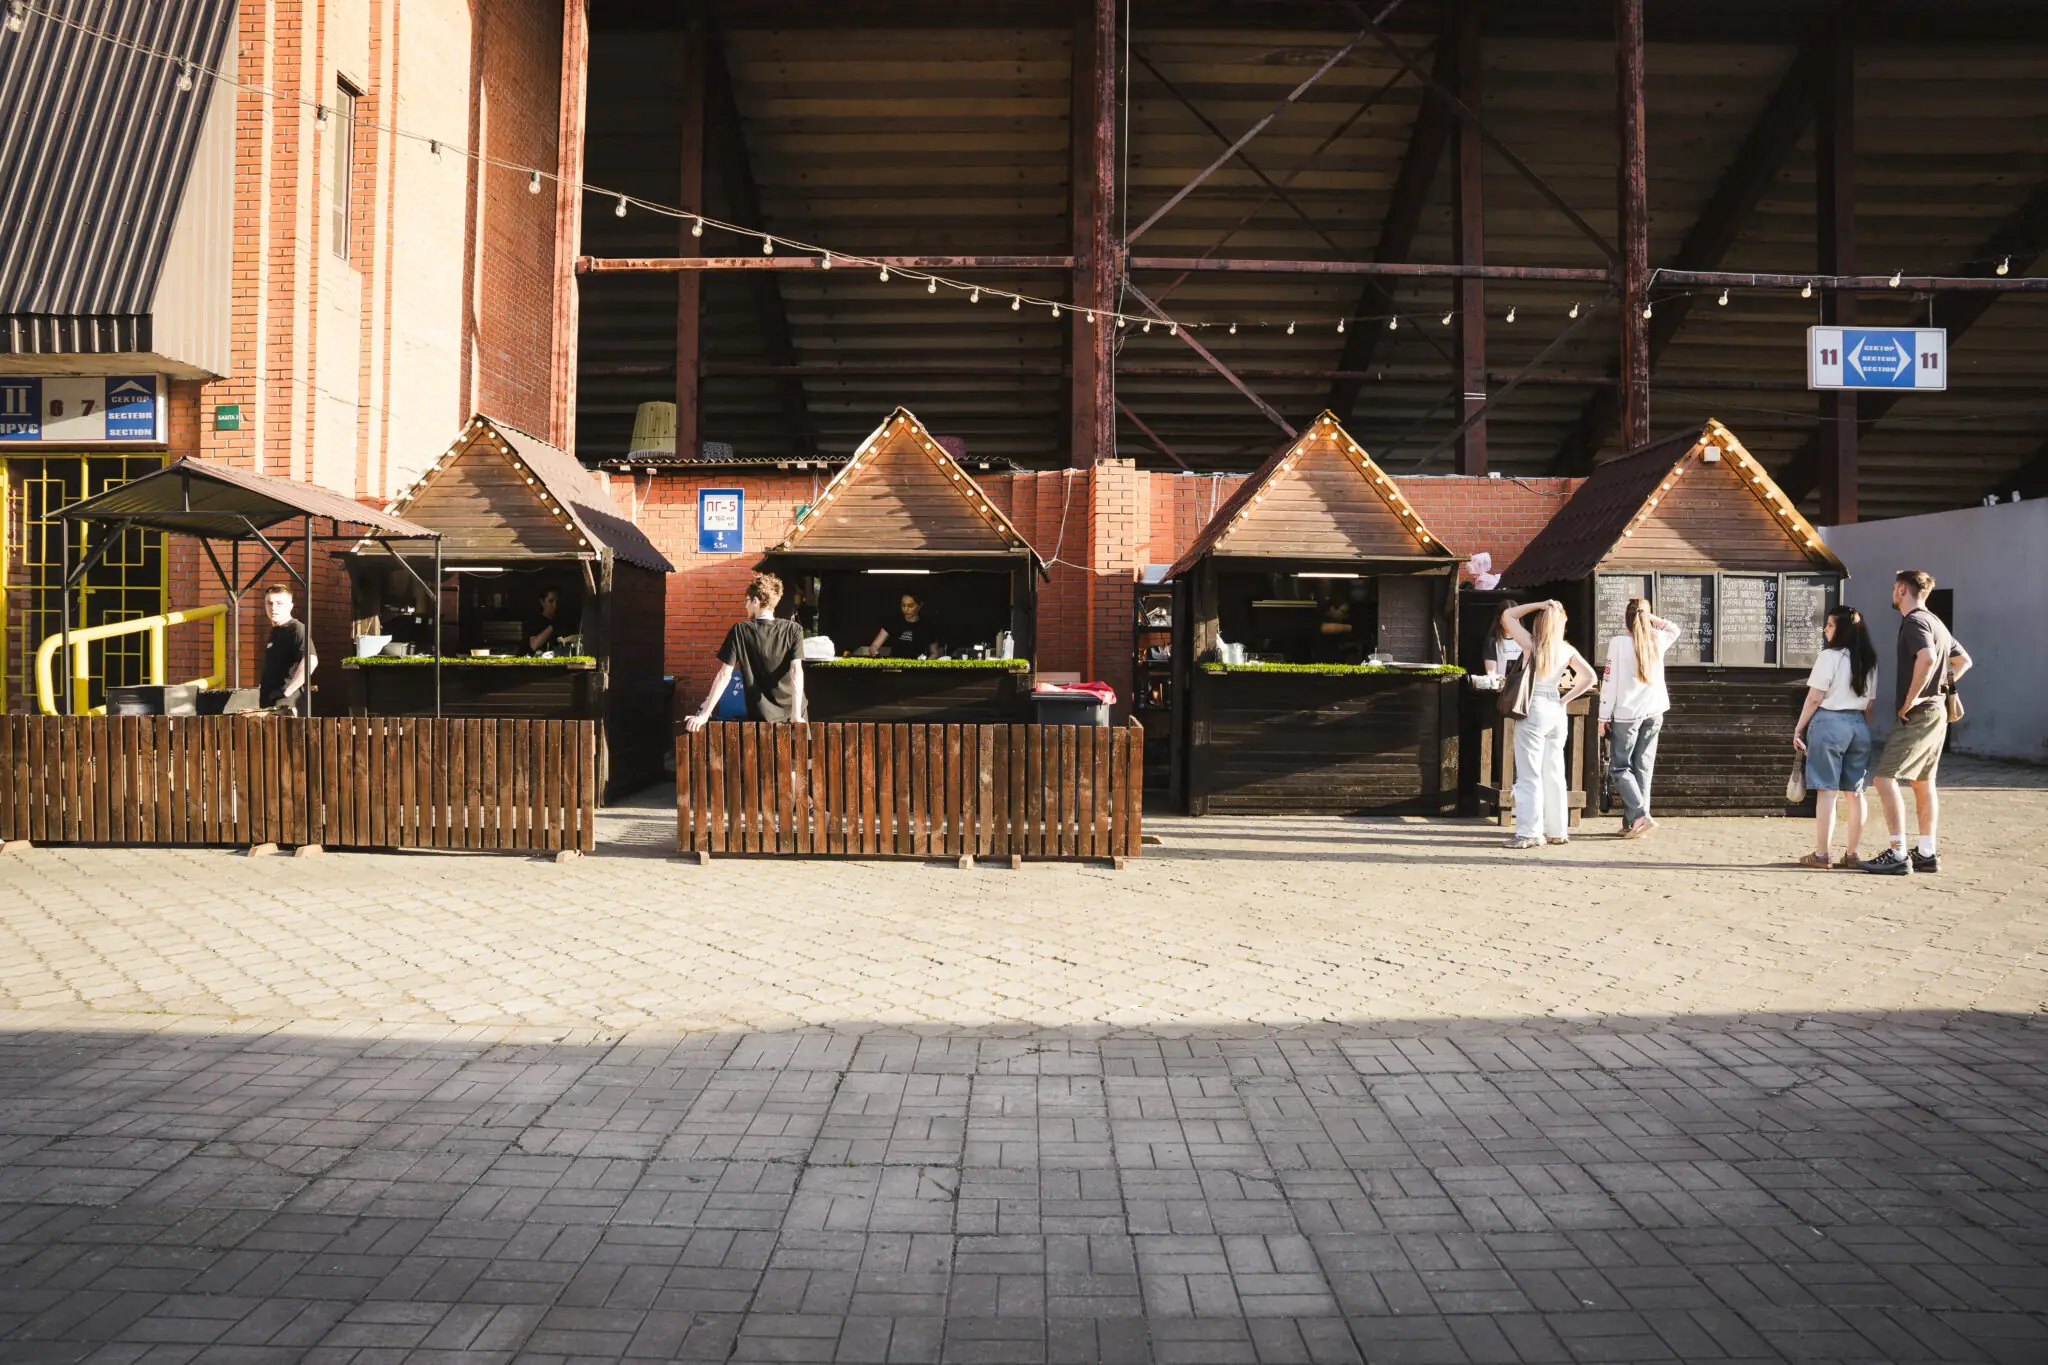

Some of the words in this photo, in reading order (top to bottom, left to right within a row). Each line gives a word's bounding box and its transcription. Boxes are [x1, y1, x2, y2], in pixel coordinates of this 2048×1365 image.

[1820, 349, 1838, 366] 11
[1920, 352, 1938, 369] 11
[49, 399, 63, 417] 6
[80, 399, 95, 417] 7
[108, 412, 153, 420] SECTEUR
[109, 428, 152, 436] SECTION
